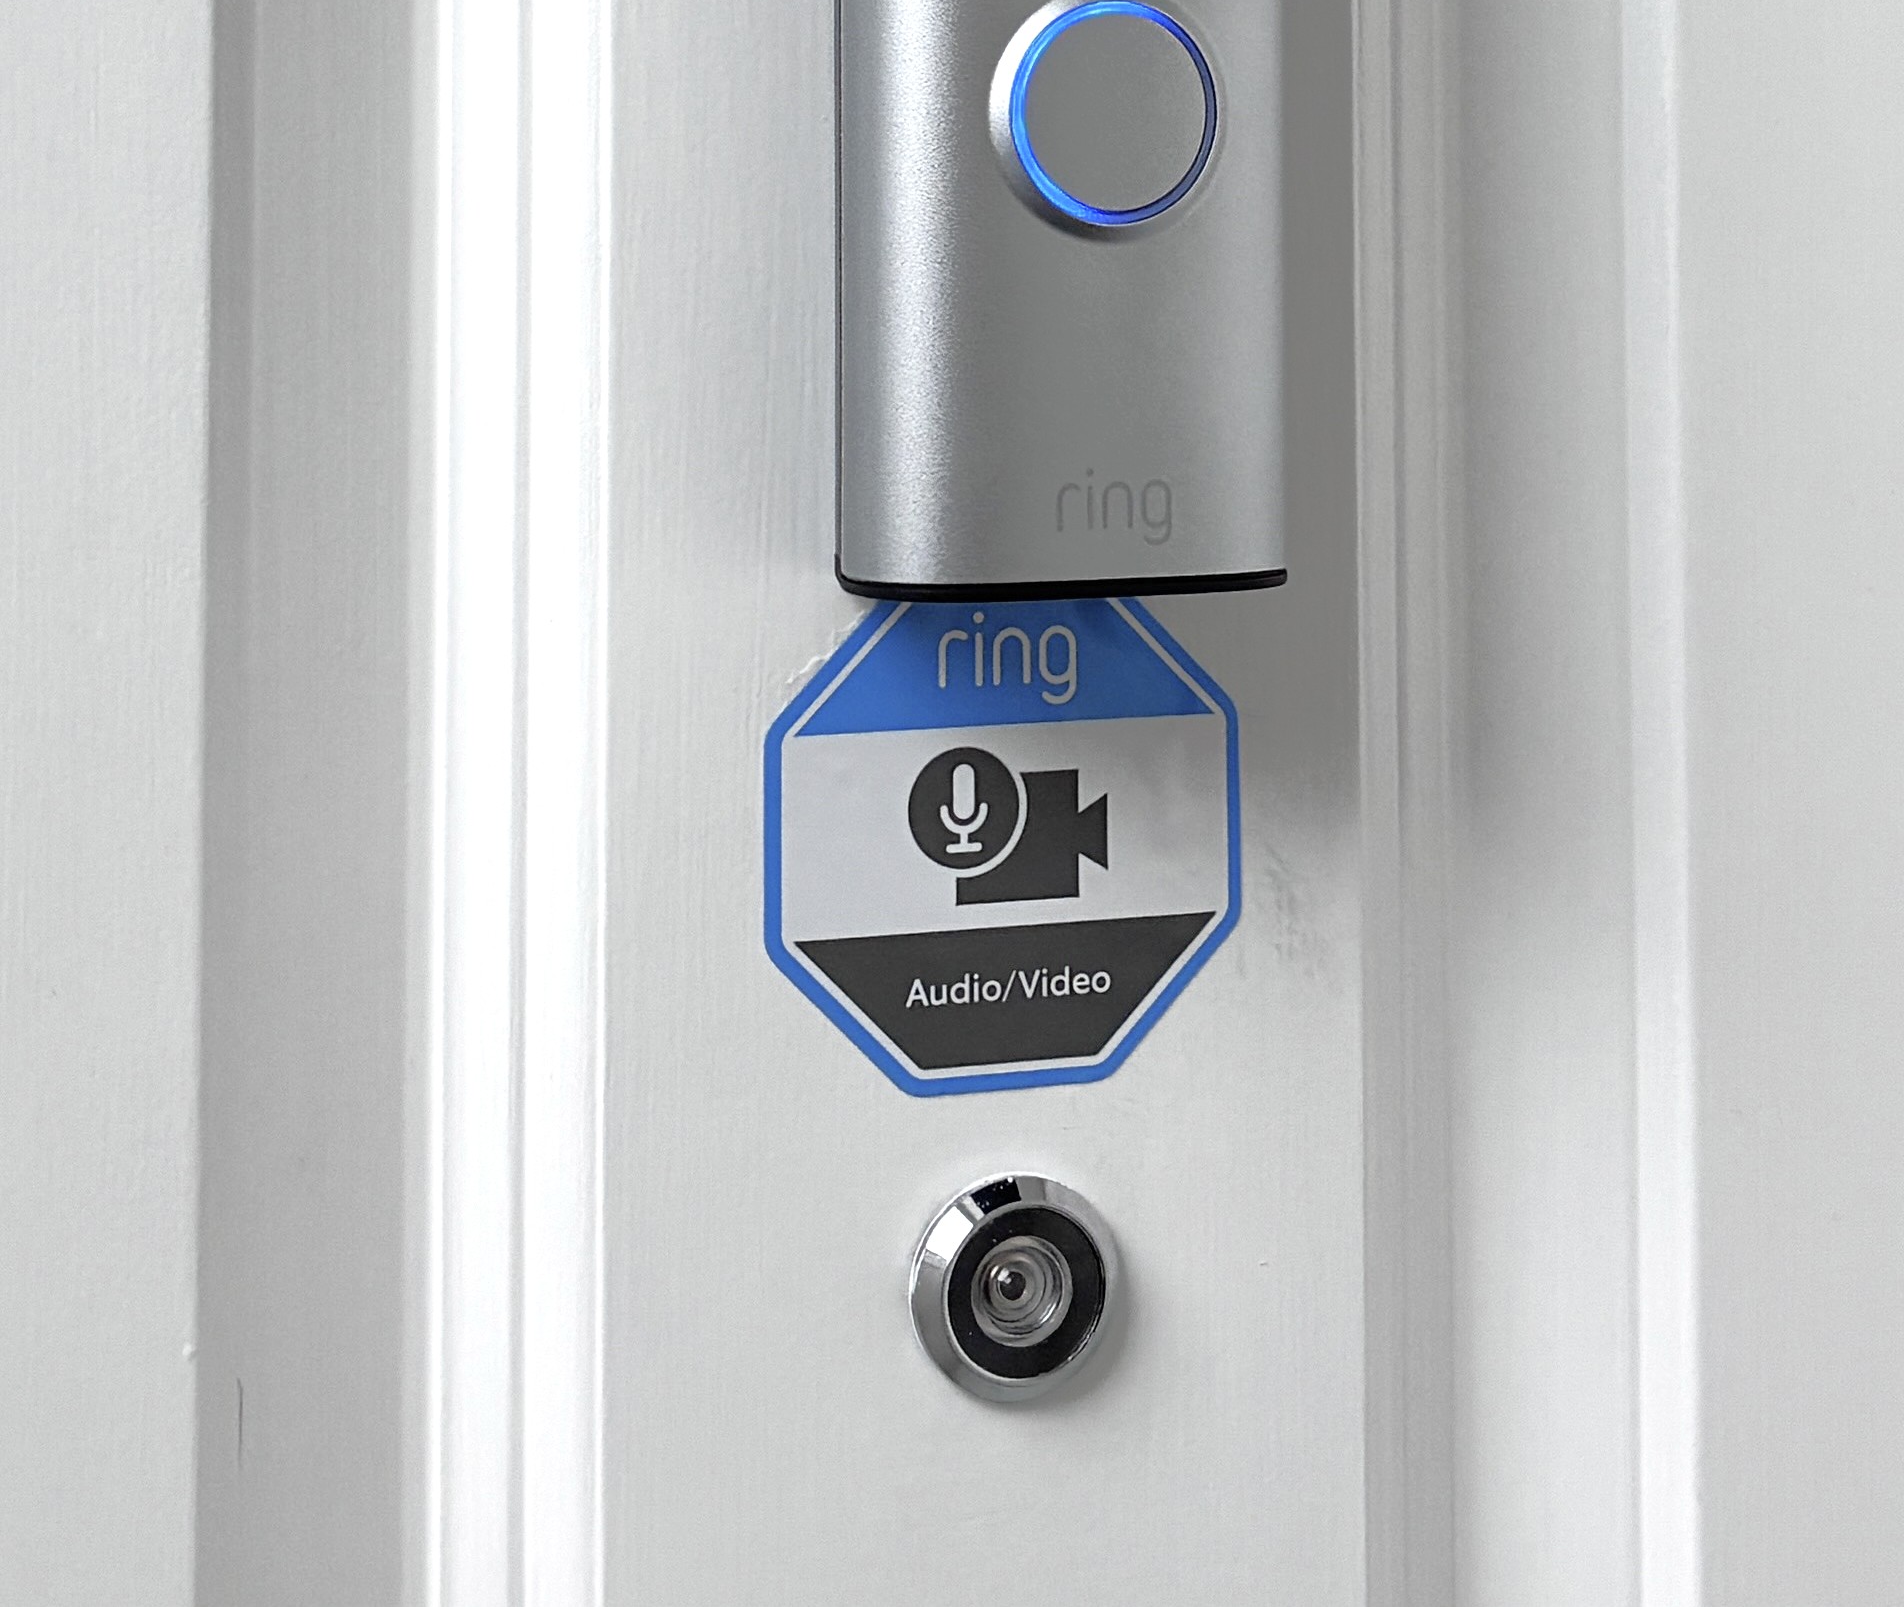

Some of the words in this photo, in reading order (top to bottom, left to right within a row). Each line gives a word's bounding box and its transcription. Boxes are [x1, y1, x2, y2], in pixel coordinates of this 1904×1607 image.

[1056, 468, 1173, 545] ring
[938, 612, 1077, 705] ring
[905, 966, 1112, 1008] Audio/Video
